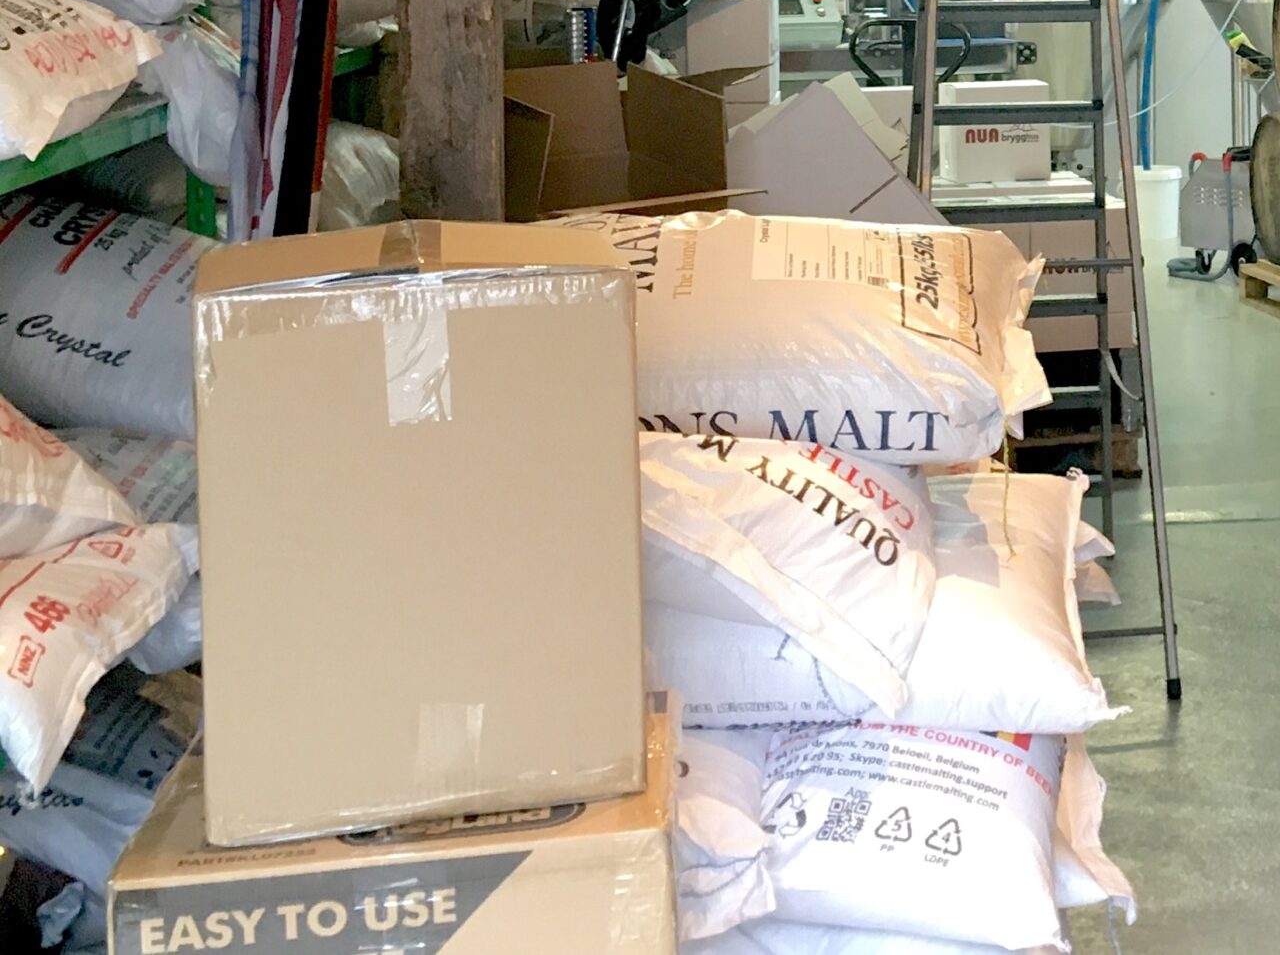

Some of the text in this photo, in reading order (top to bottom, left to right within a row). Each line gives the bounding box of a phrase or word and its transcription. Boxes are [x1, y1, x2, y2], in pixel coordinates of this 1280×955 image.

[965, 128, 999, 144] NUA
[675, 241, 696, 271] home
[16, 314, 132, 367] Crystal
[768, 409, 949, 451] MALT
[745, 455, 902, 567] QUALITY
[24, 595, 71, 634] 466
[862, 740, 891, 753] 7970
[935, 754, 981, 775] Belgium
[923, 727, 1001, 759] COUNTRY
[1003, 752, 1025, 768] OF
[848, 752, 887, 768] Skype:
[888, 758, 1009, 800] castlemalting.support
[880, 843, 895, 853] PP
[924, 854, 950, 868] LDPE
[139, 887, 458, 955] EASY TO USE
